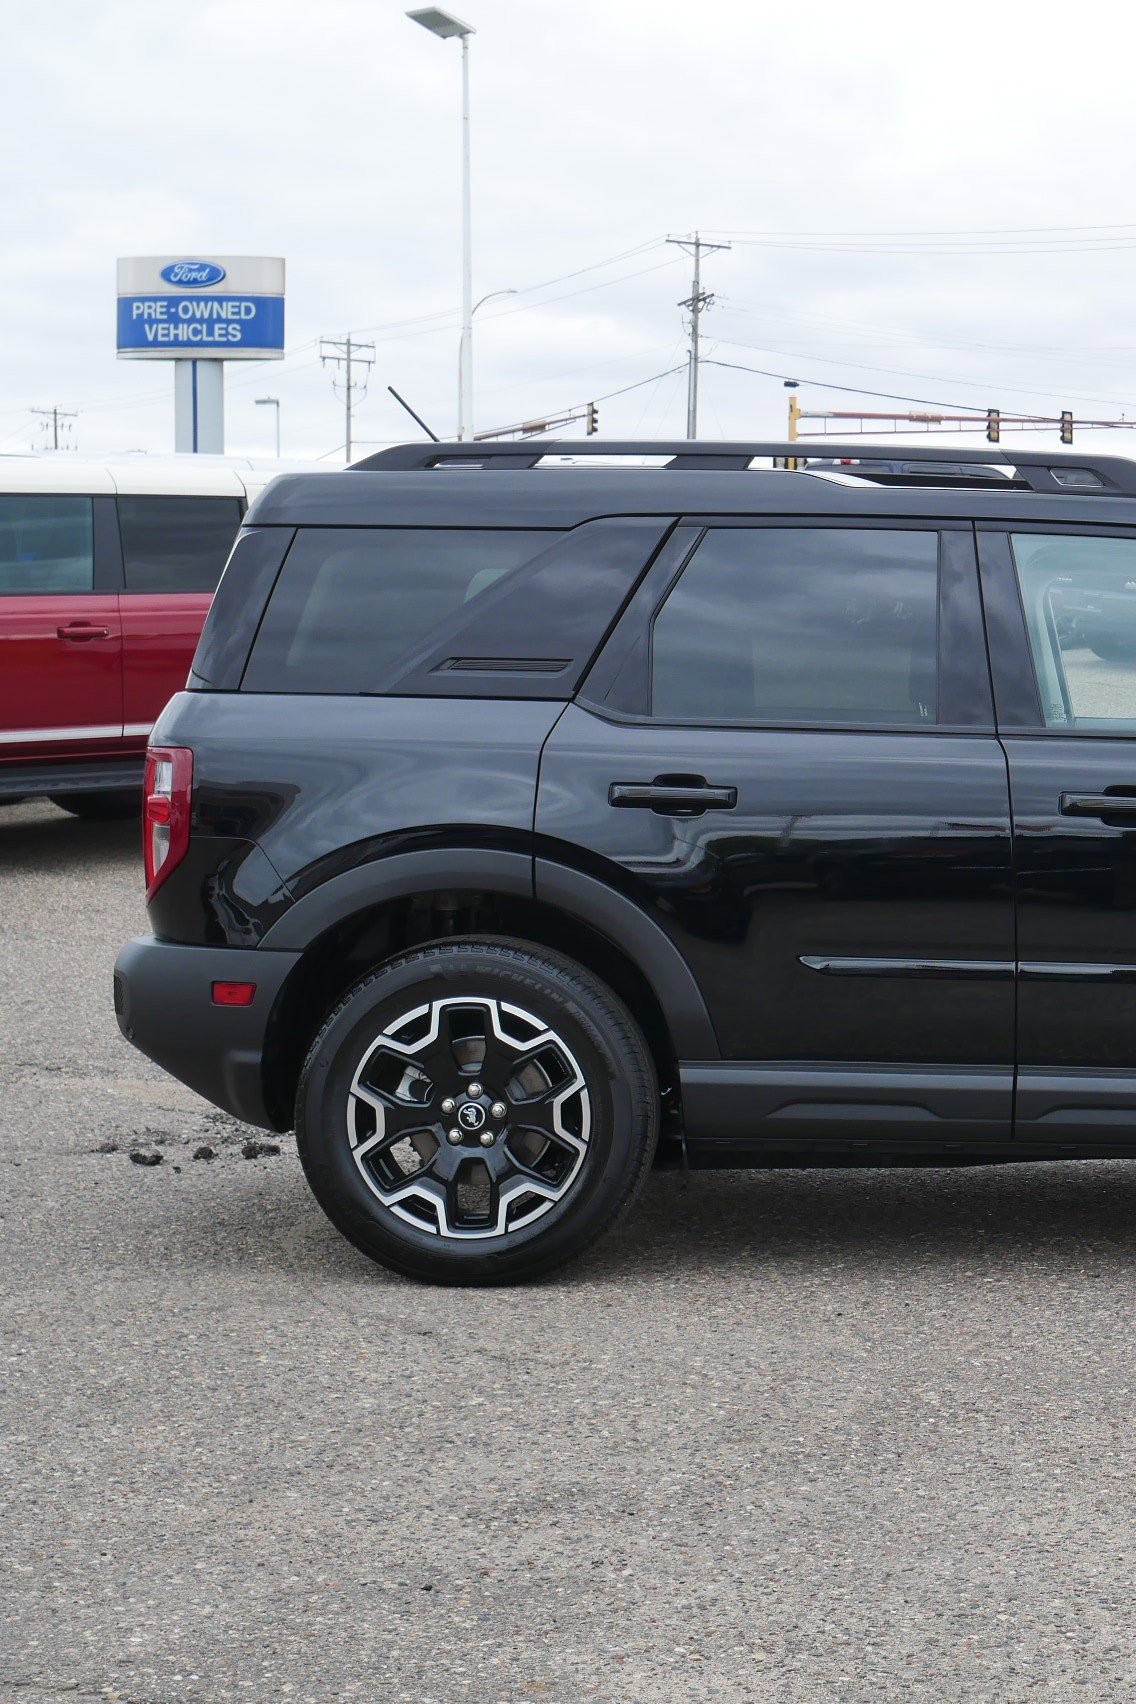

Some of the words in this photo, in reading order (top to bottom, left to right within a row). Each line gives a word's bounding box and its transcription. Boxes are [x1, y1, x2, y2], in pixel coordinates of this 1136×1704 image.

[170, 263, 210, 282] Ford
[132, 301, 256, 320] PRE-OWNED
[144, 323, 242, 341] VEHICLES
